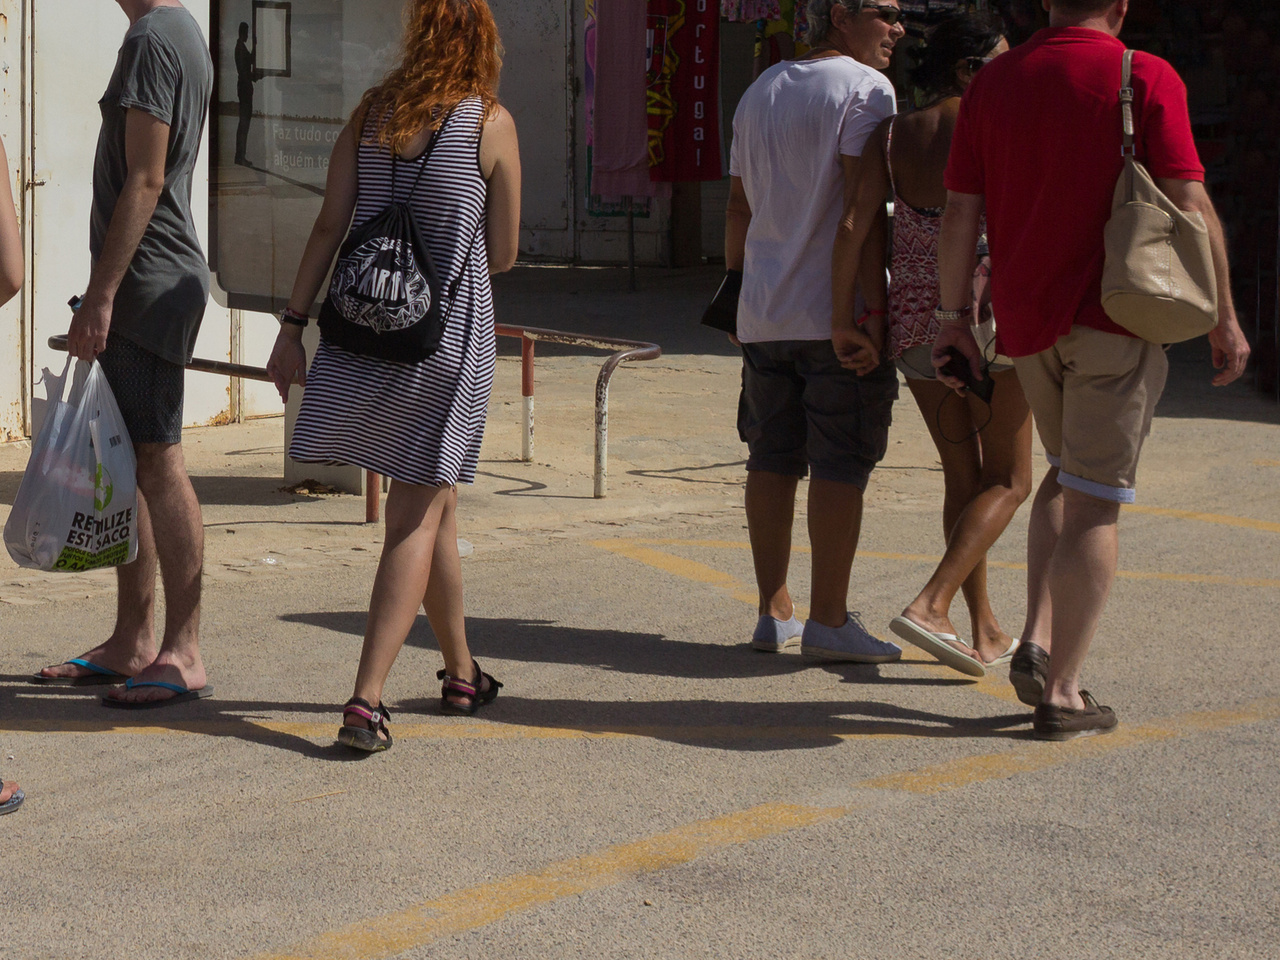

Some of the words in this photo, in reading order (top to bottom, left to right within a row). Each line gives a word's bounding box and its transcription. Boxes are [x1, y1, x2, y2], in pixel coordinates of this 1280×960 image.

[272, 123, 291, 140] Faz
[294, 125, 322, 141] tudo
[324, 130, 340, 143] co
[274, 150, 314, 172] alguém
[317, 155, 329, 170] te
